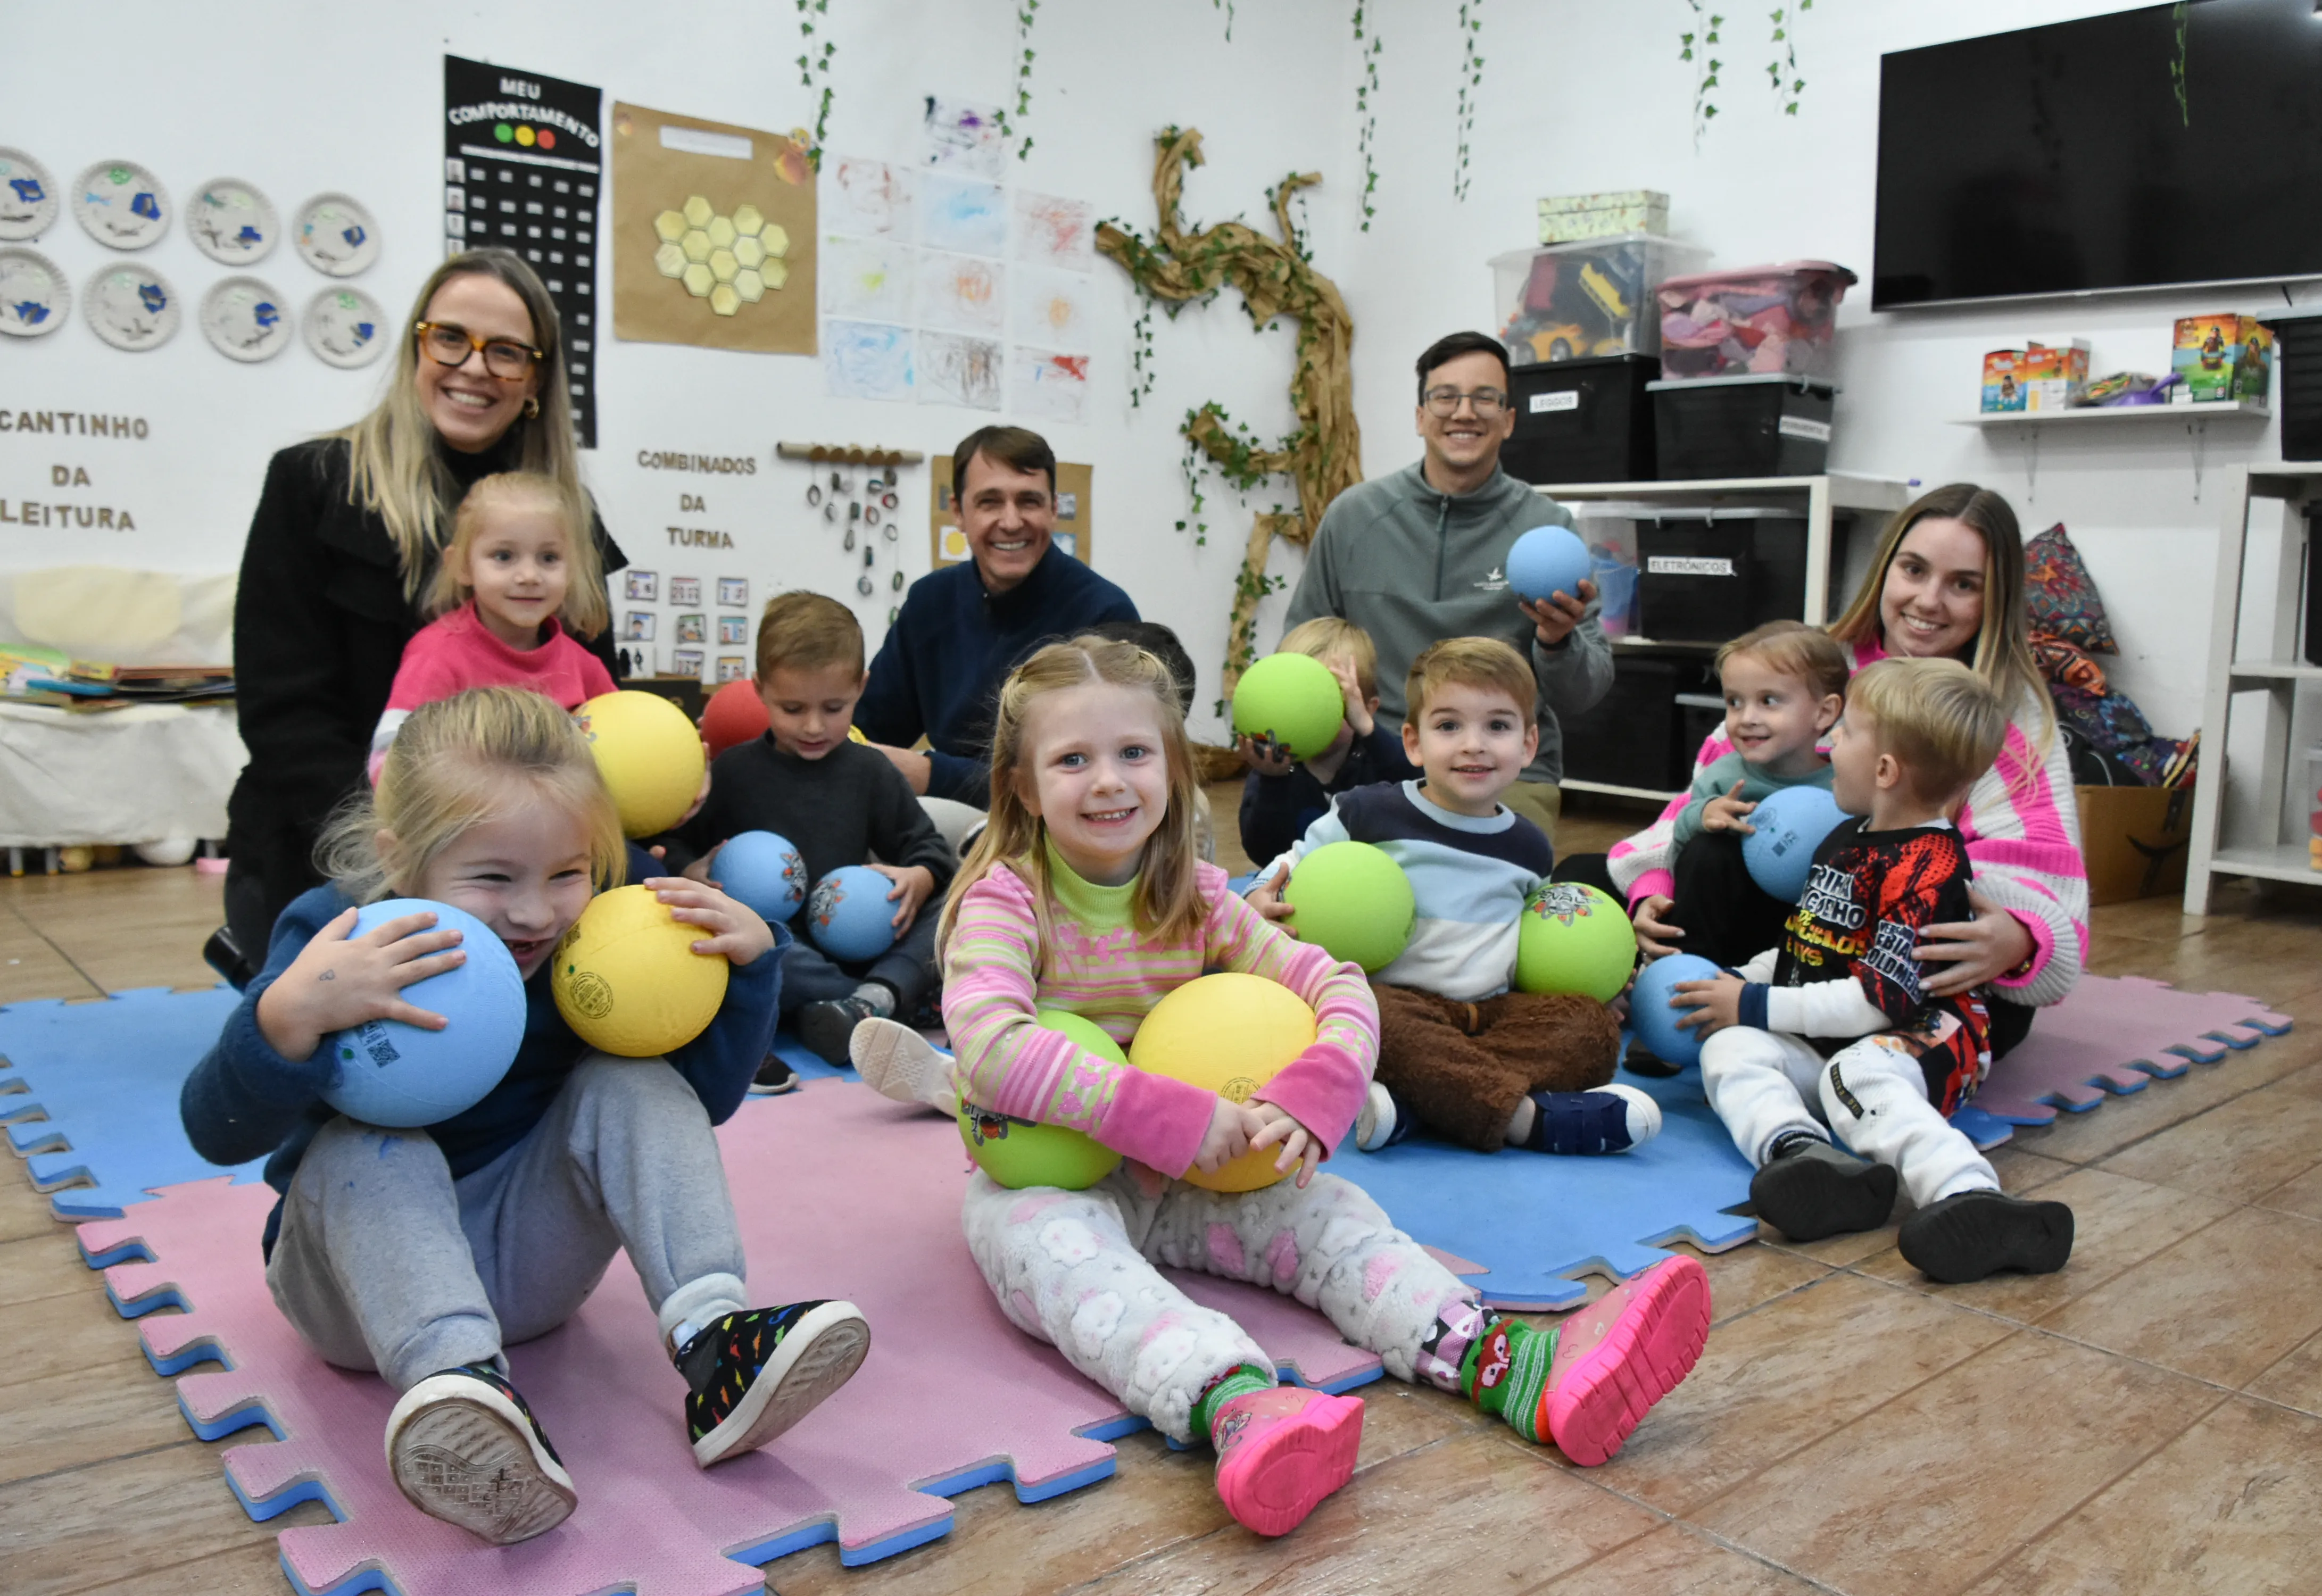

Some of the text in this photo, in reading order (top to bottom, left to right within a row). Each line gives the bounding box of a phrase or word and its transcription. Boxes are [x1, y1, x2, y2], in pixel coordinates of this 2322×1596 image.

[499, 77, 541, 99] MEU
[448, 102, 600, 148] COMPORTAMENTO
[0, 410, 149, 440] CANTINHO
[638, 450, 757, 475] COMBINADOS
[52, 464, 91, 487] DA
[0, 499, 136, 531] LEITURA
[680, 493, 706, 513] DA
[667, 526, 734, 550] TURMA
